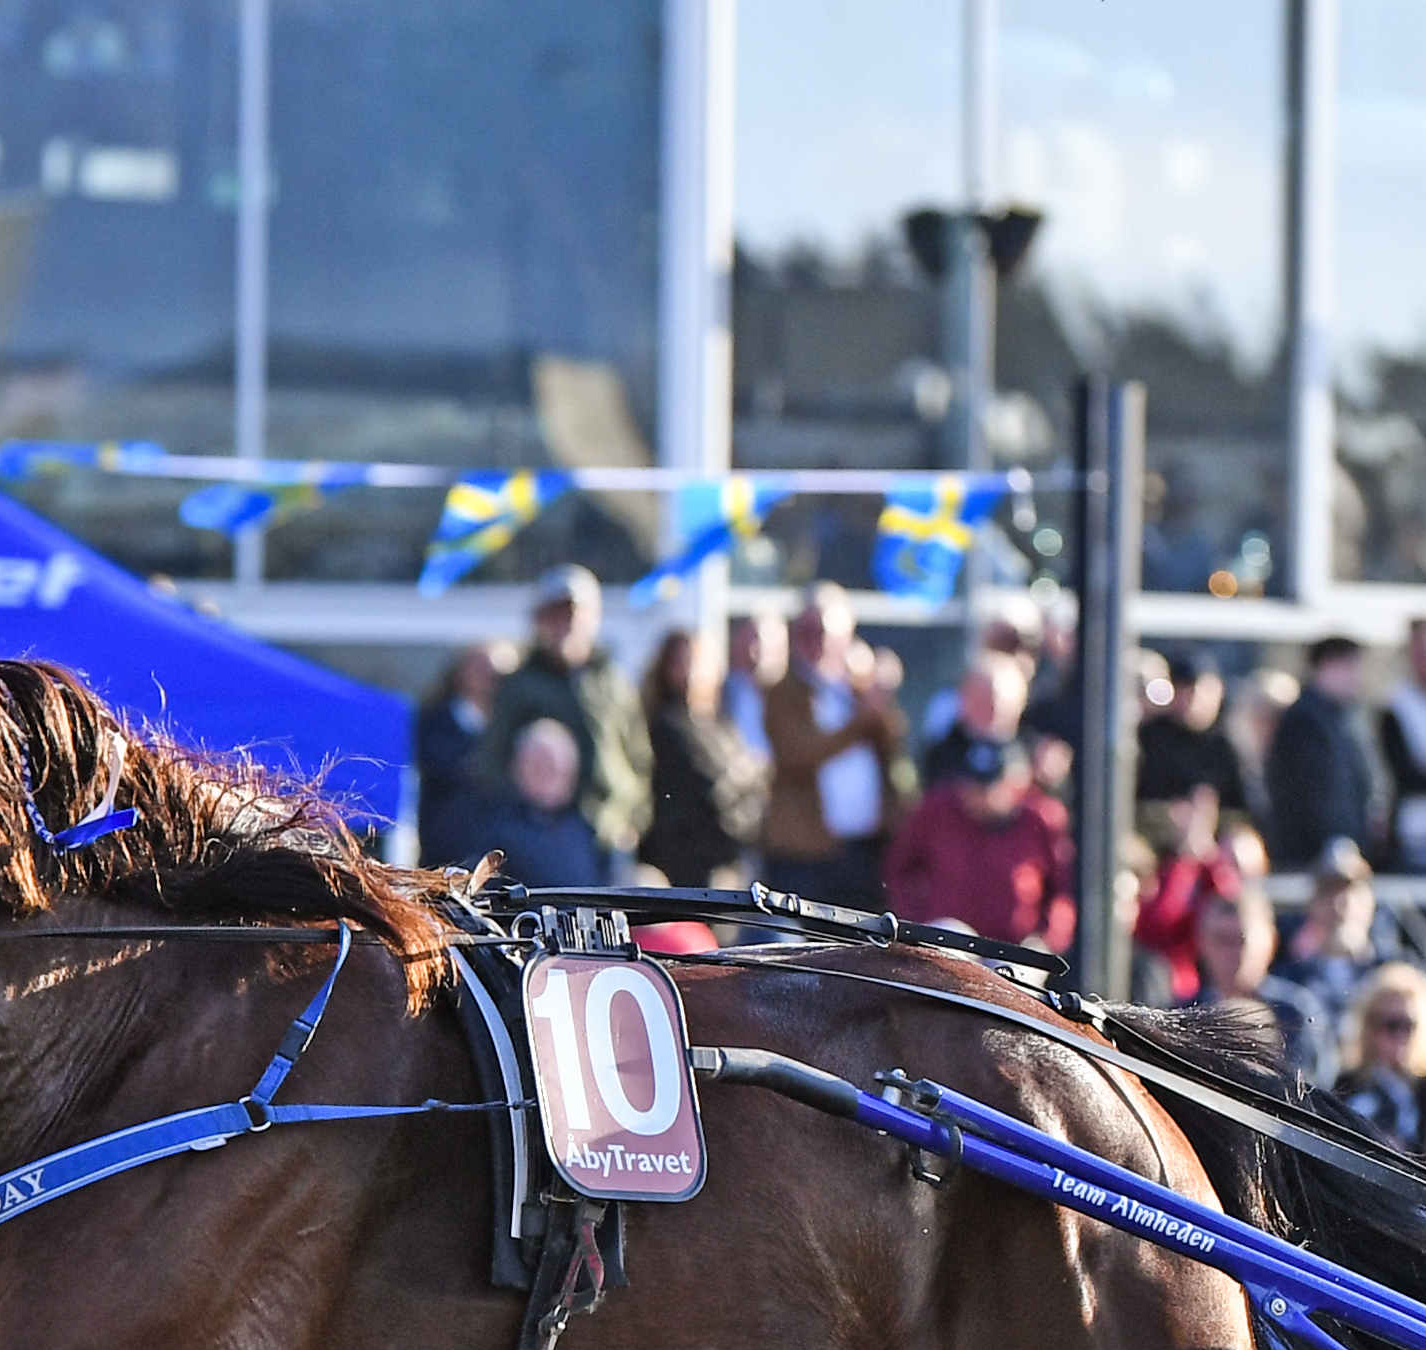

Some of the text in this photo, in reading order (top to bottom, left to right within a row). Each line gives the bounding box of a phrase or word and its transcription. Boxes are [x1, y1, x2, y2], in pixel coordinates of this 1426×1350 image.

[533, 966, 681, 1136] 10
[565, 1133, 693, 1177] ÅbyTravet
[1052, 1168, 1216, 1253] Team Almheden
